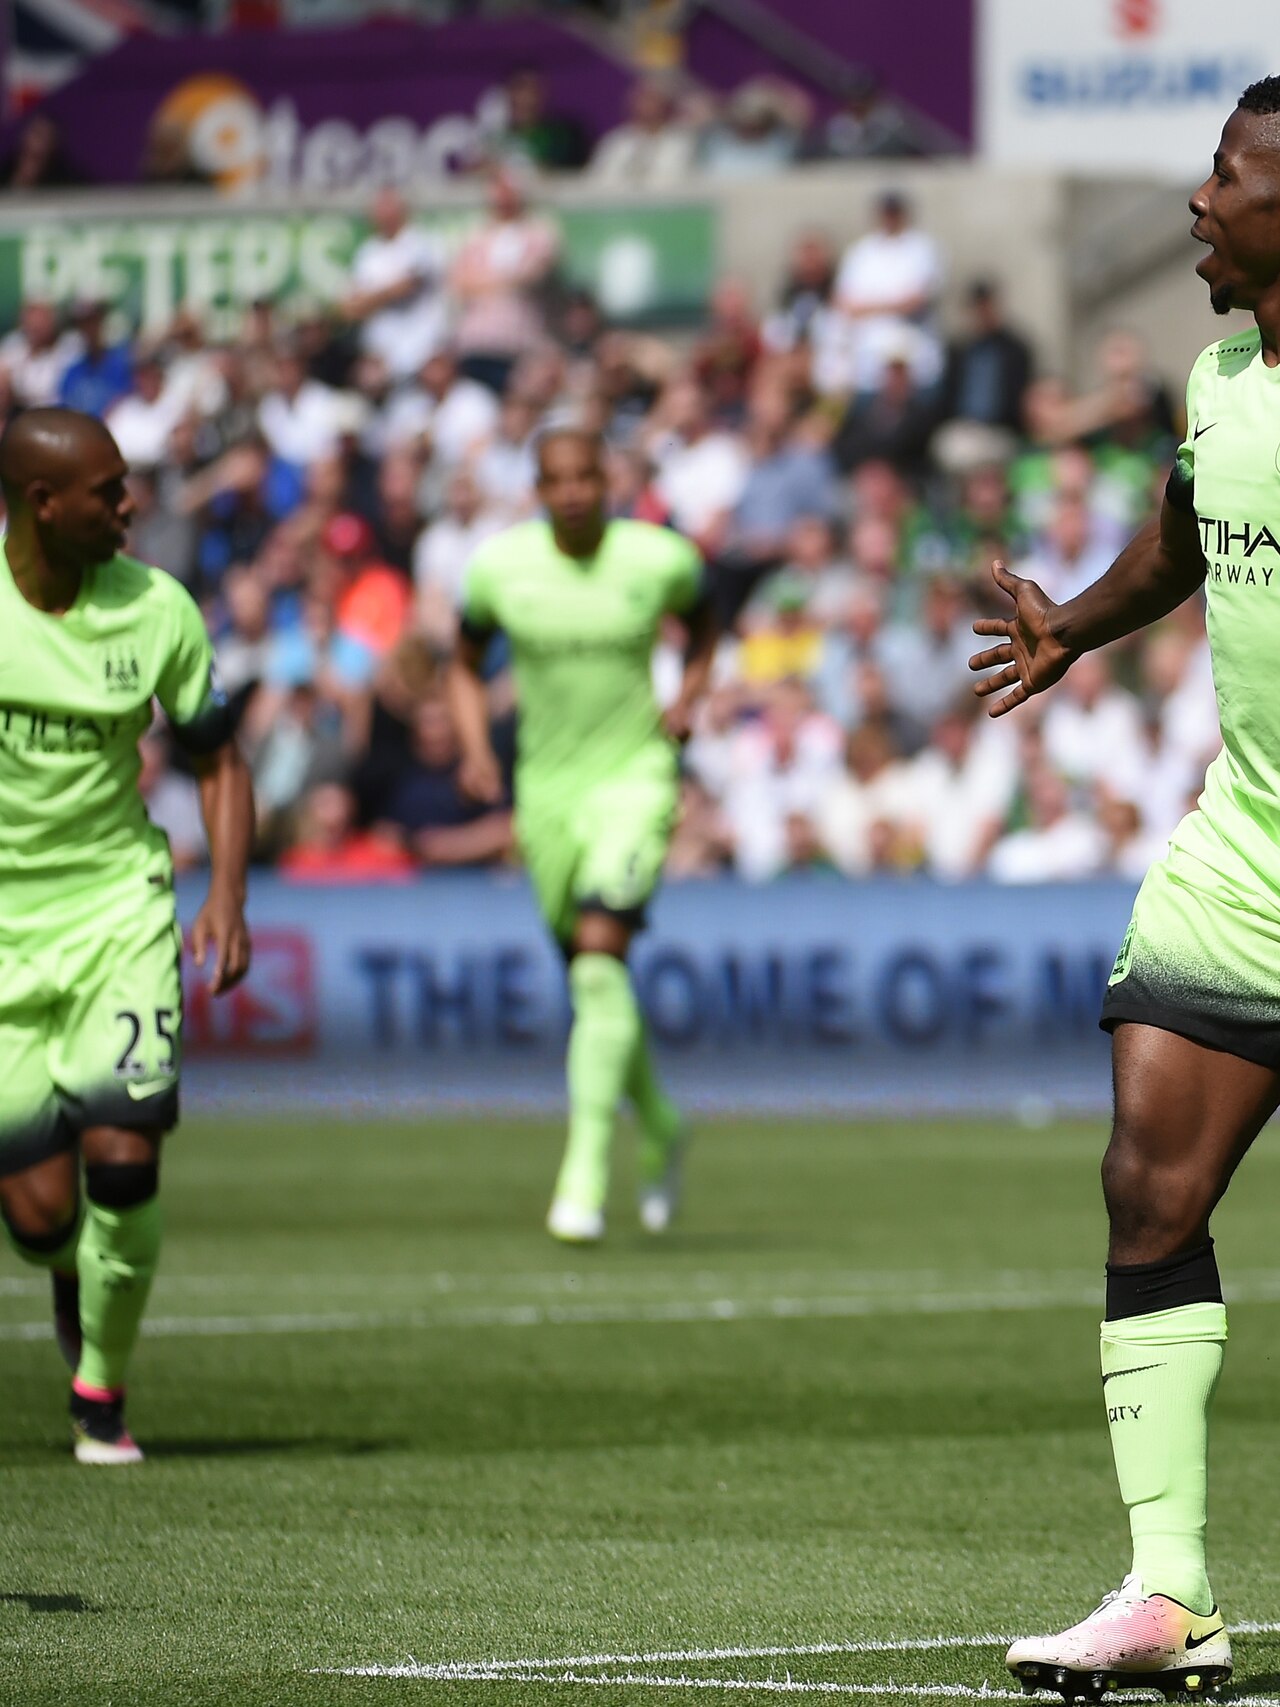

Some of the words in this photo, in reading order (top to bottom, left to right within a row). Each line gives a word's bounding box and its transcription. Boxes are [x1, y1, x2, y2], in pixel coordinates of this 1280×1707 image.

[356, 944, 536, 1050] THE
[648, 938, 854, 1048] OME
[880, 940, 1008, 1048] OF
[115, 1006, 176, 1077] 25
